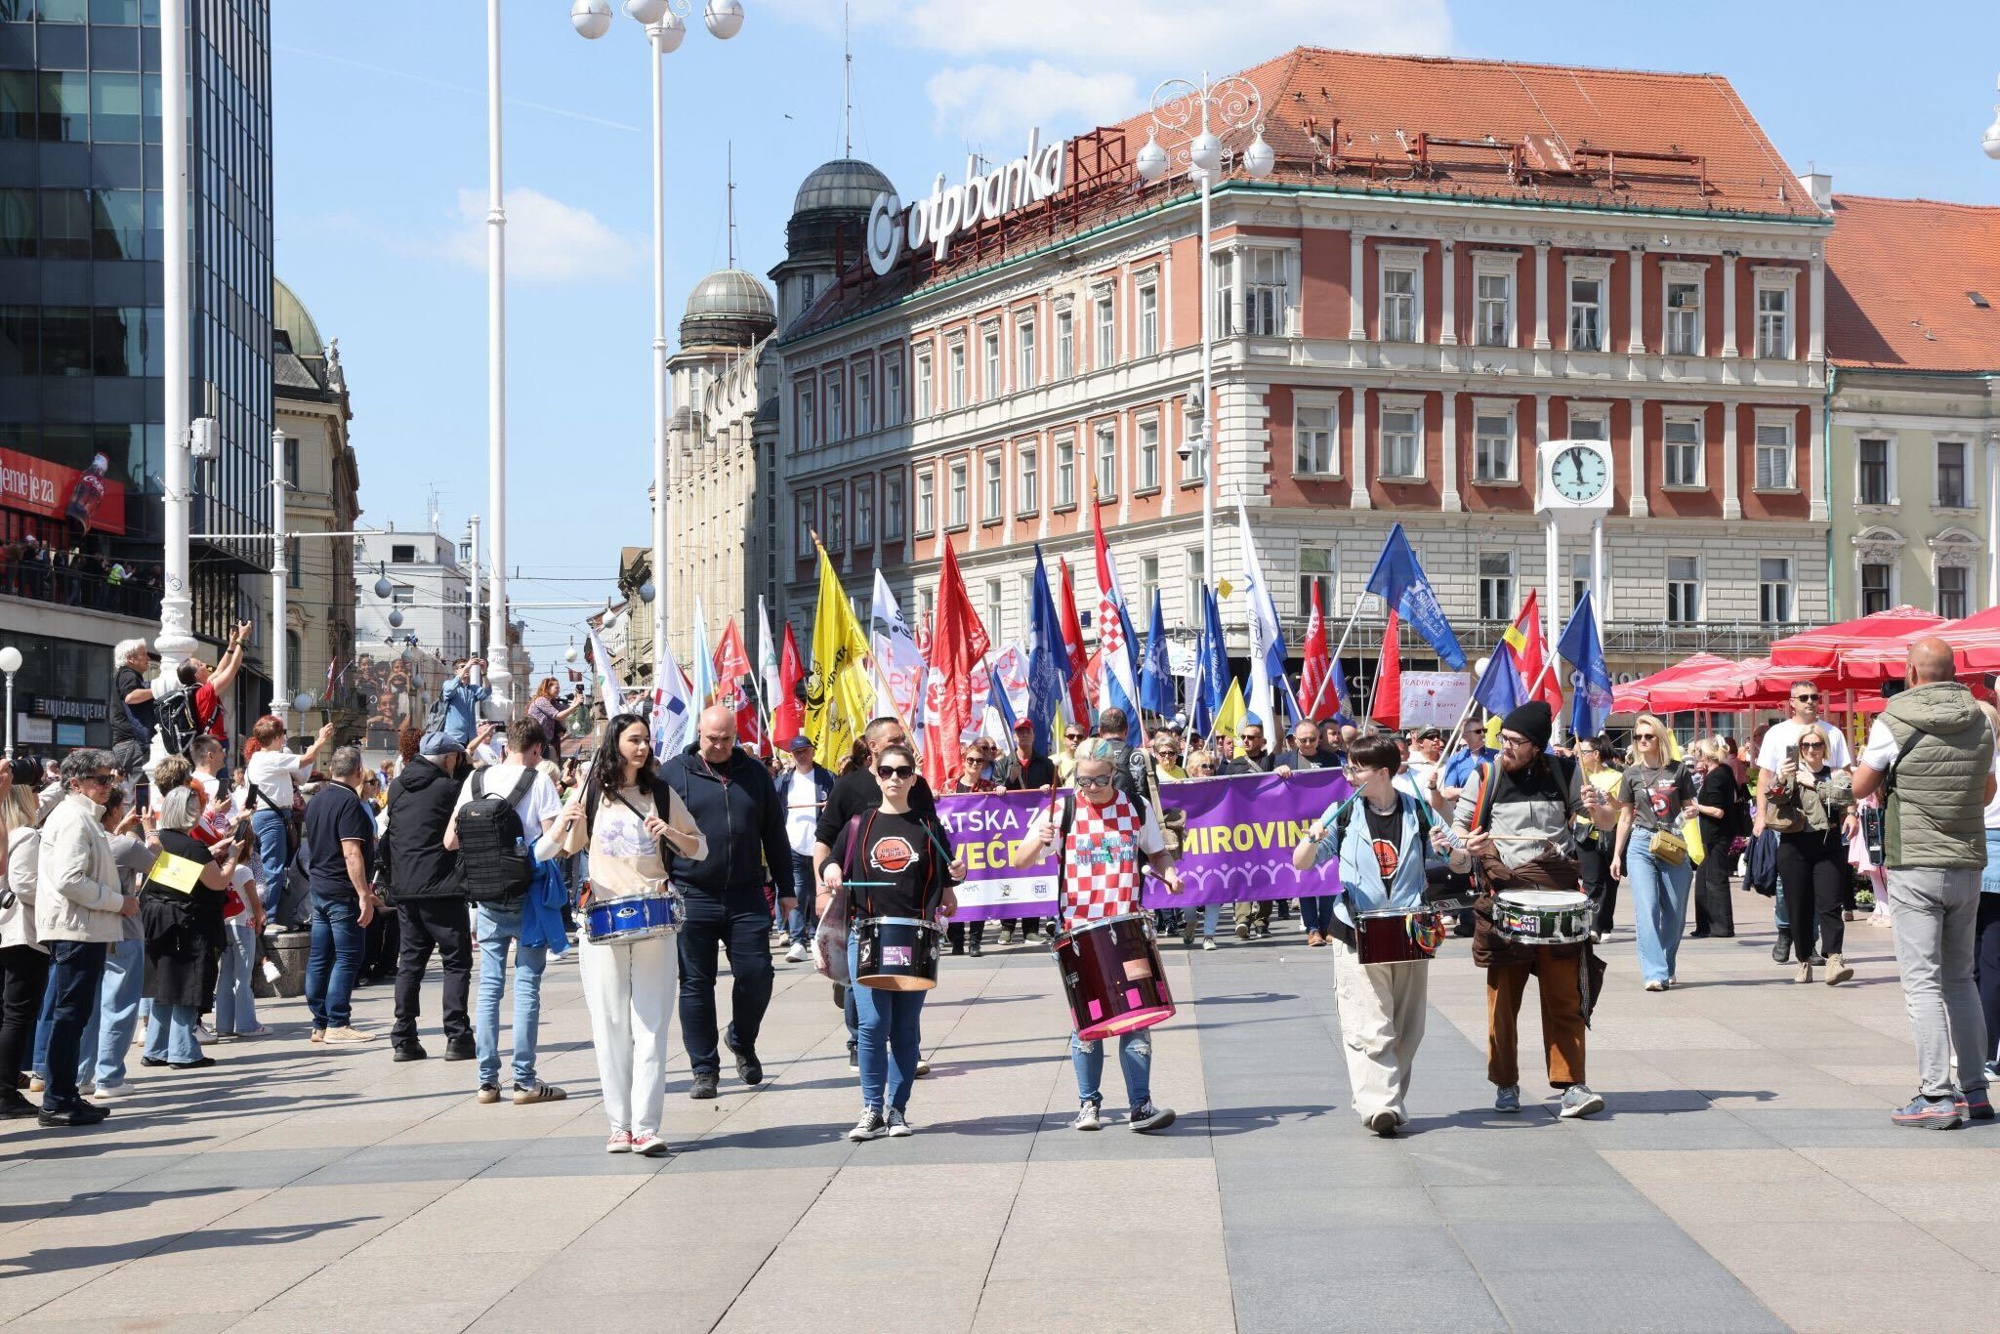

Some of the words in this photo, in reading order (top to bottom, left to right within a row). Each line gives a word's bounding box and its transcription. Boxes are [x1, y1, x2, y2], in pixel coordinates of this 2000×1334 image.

[29, 469, 39, 501] je
[41, 479, 54, 503] za
[1182, 818, 1320, 855] MIROVIN
[1521, 924, 1536, 932] 041
[1522, 914, 1535, 924] ZG
